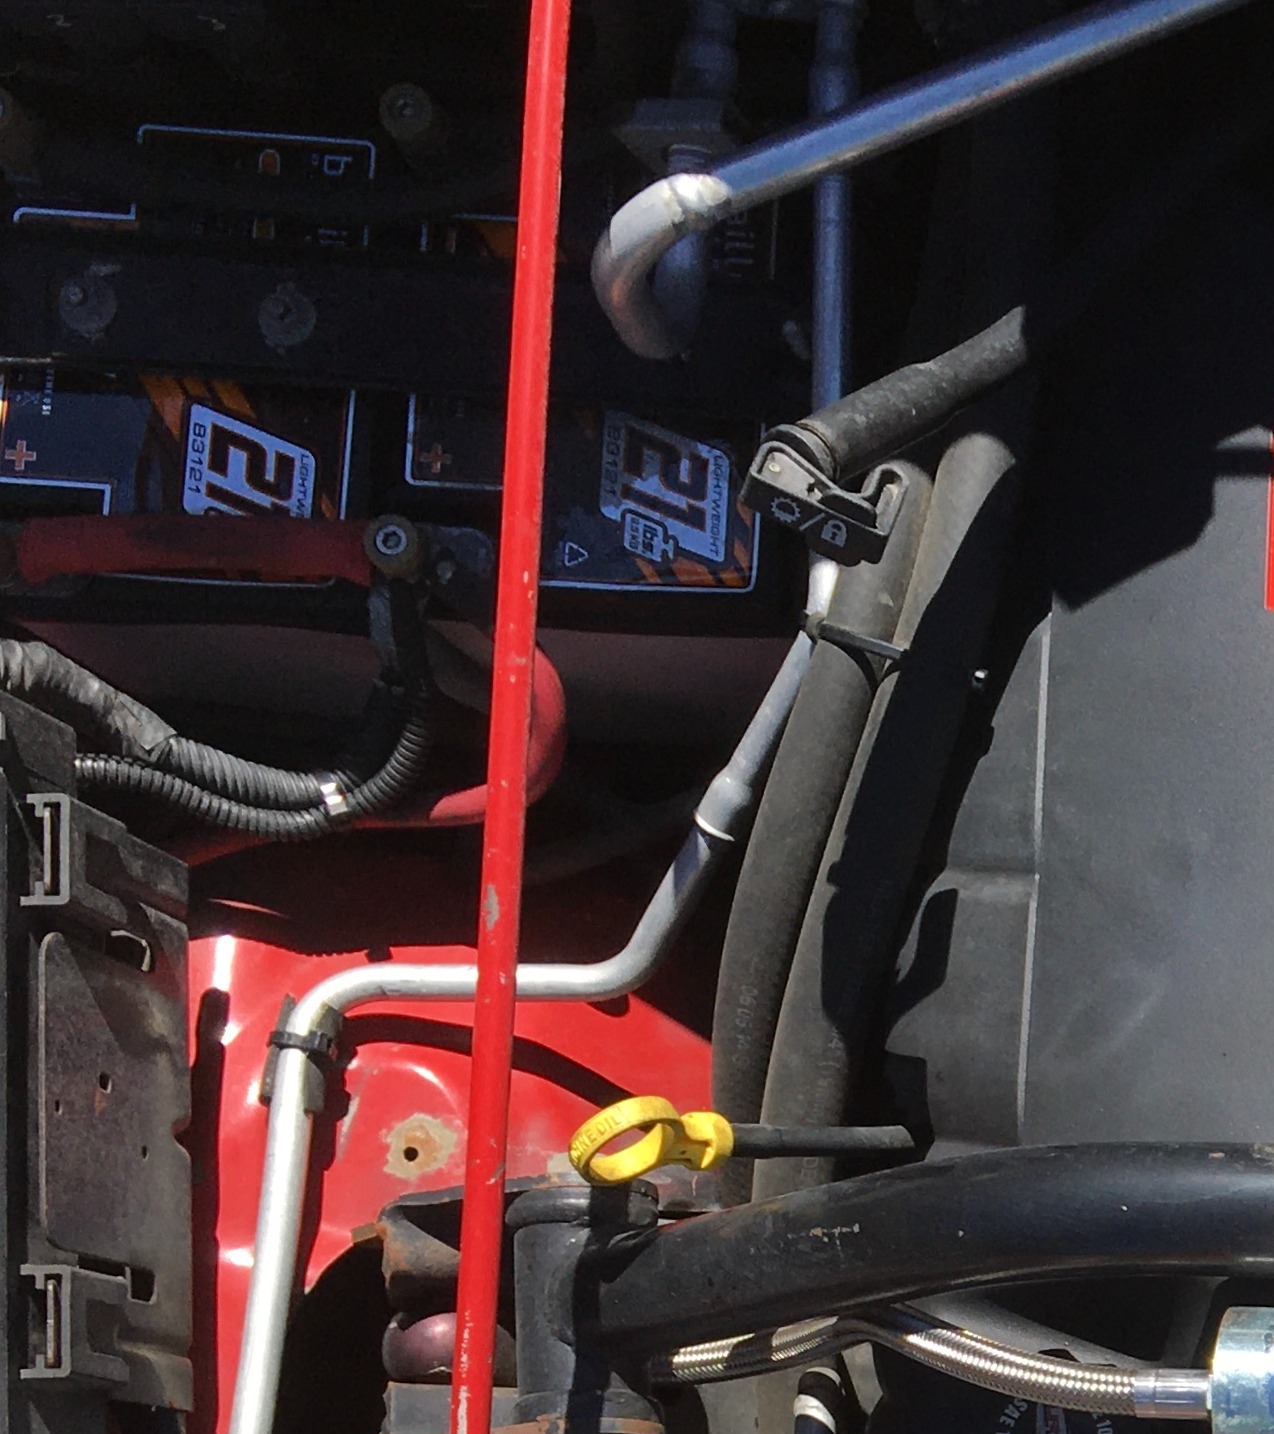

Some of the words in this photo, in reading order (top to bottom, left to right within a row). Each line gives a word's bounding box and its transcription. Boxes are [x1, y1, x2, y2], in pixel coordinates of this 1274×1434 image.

[188, 422, 206, 493] B3121
[622, 425, 709, 534] 21
[708, 454, 724, 557] LIGHTWEIGHT
